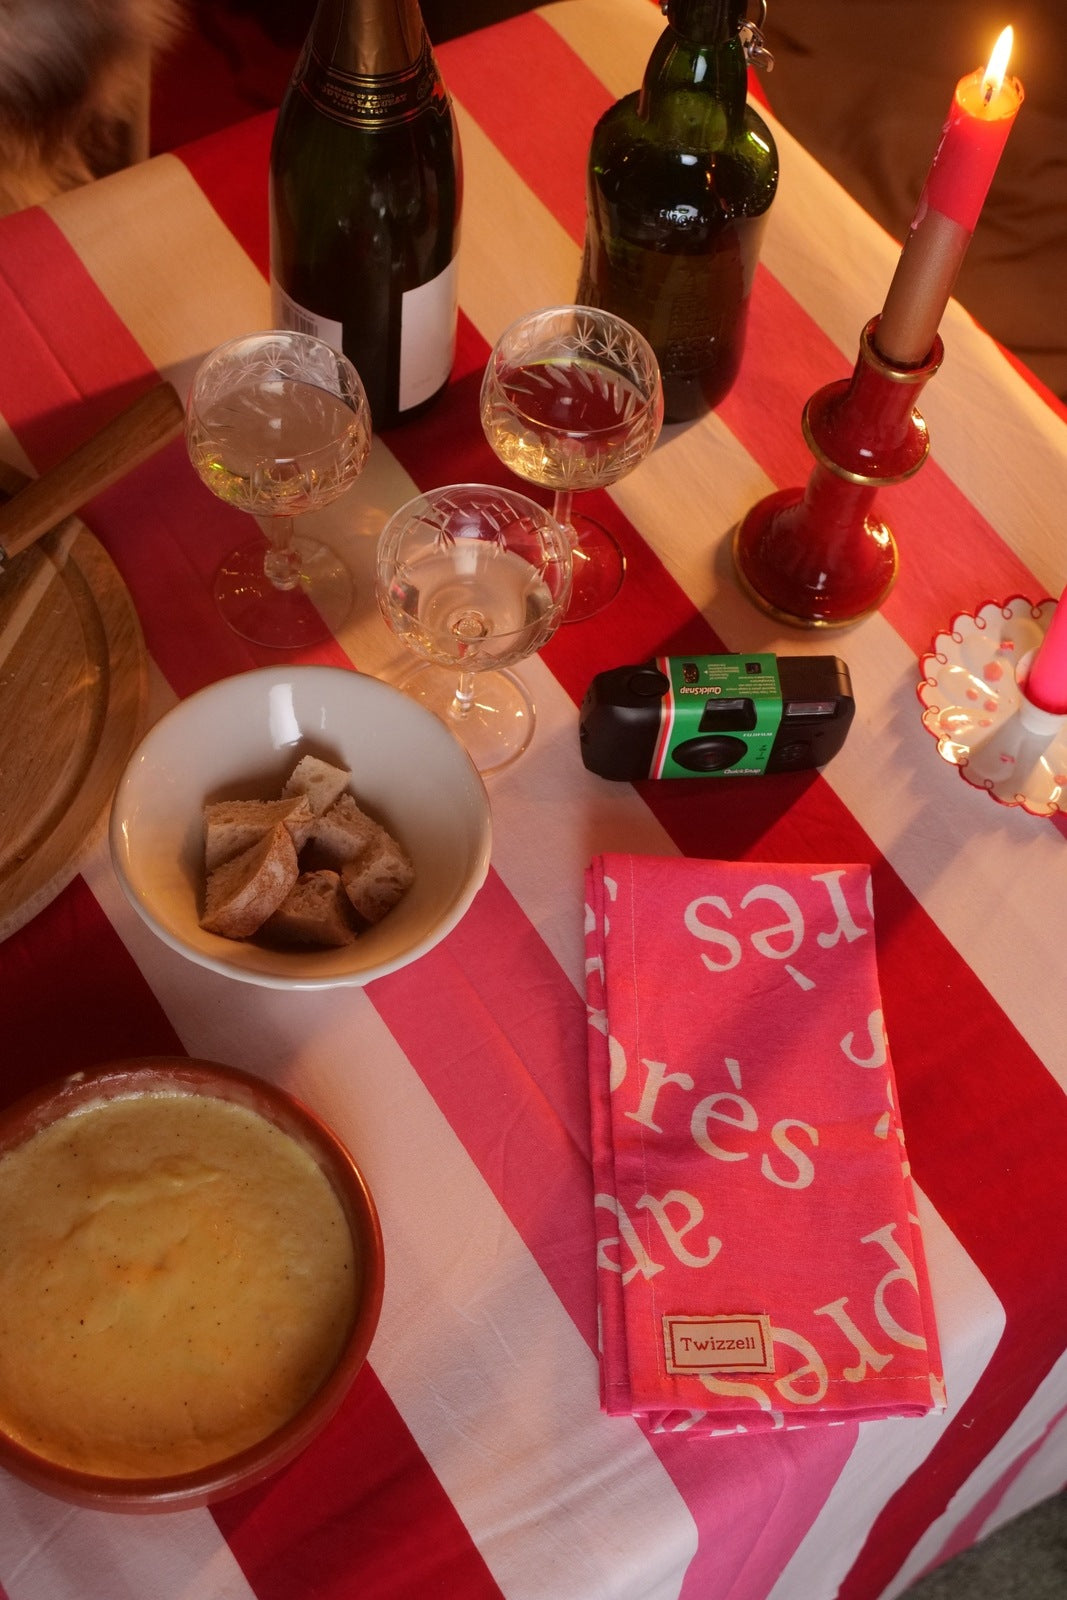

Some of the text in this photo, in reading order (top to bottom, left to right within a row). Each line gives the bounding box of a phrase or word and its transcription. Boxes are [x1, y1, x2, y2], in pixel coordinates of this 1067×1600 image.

[680, 685, 722, 695] QuickSnap
[684, 870, 873, 991] rès
[680, 1336, 756, 1353] Twizzell
